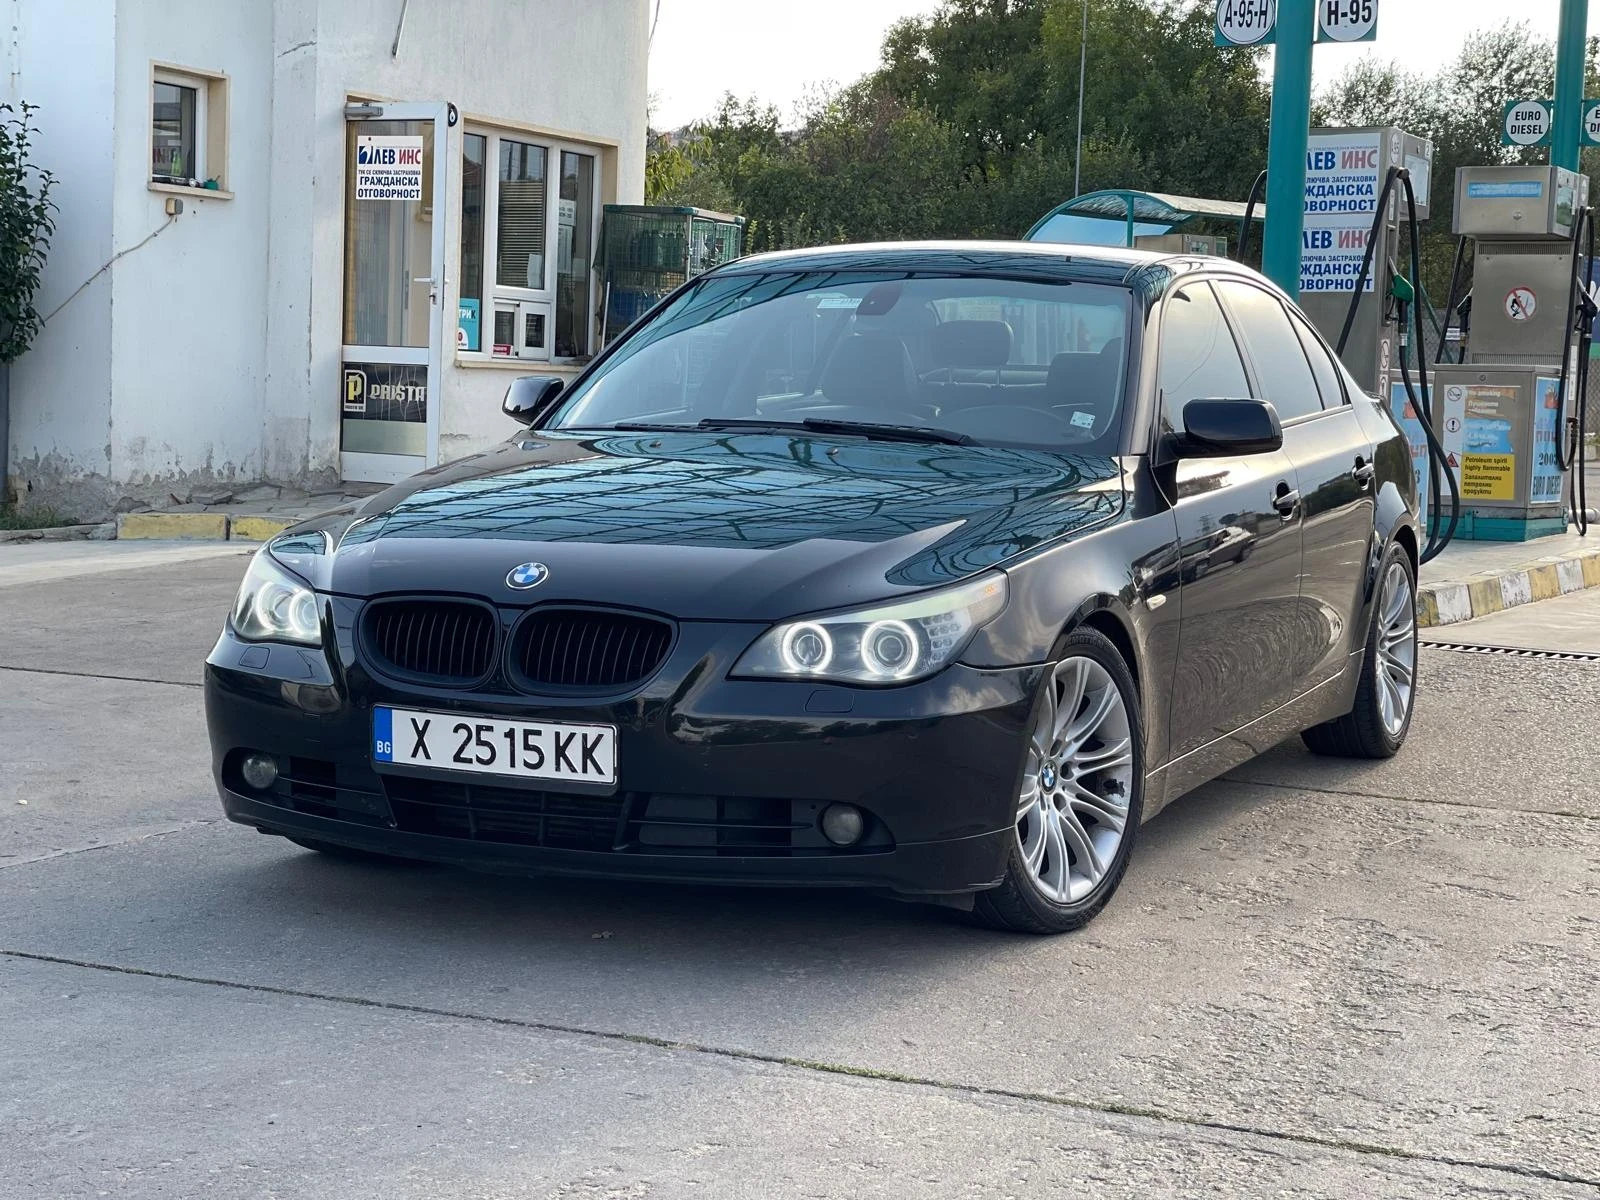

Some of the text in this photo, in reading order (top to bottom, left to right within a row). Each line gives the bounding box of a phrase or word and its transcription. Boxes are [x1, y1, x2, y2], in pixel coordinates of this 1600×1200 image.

[1515, 111, 1541, 121] EURO
[1510, 124, 1544, 135] DIESEL
[373, 148, 421, 165] ЛЕВ ИНС
[1341, 150, 1378, 169] ИНС
[360, 176, 419, 187] ГРАЖДАНСКА
[1331, 175, 1377, 183] ЗАСТРАХОВКА
[358, 188, 421, 199] ОТГОВОРНОСТ
[1300, 263, 1370, 277] ЖДАНСК
[376, 741, 391, 754] BG
[410, 717, 432, 760] X
